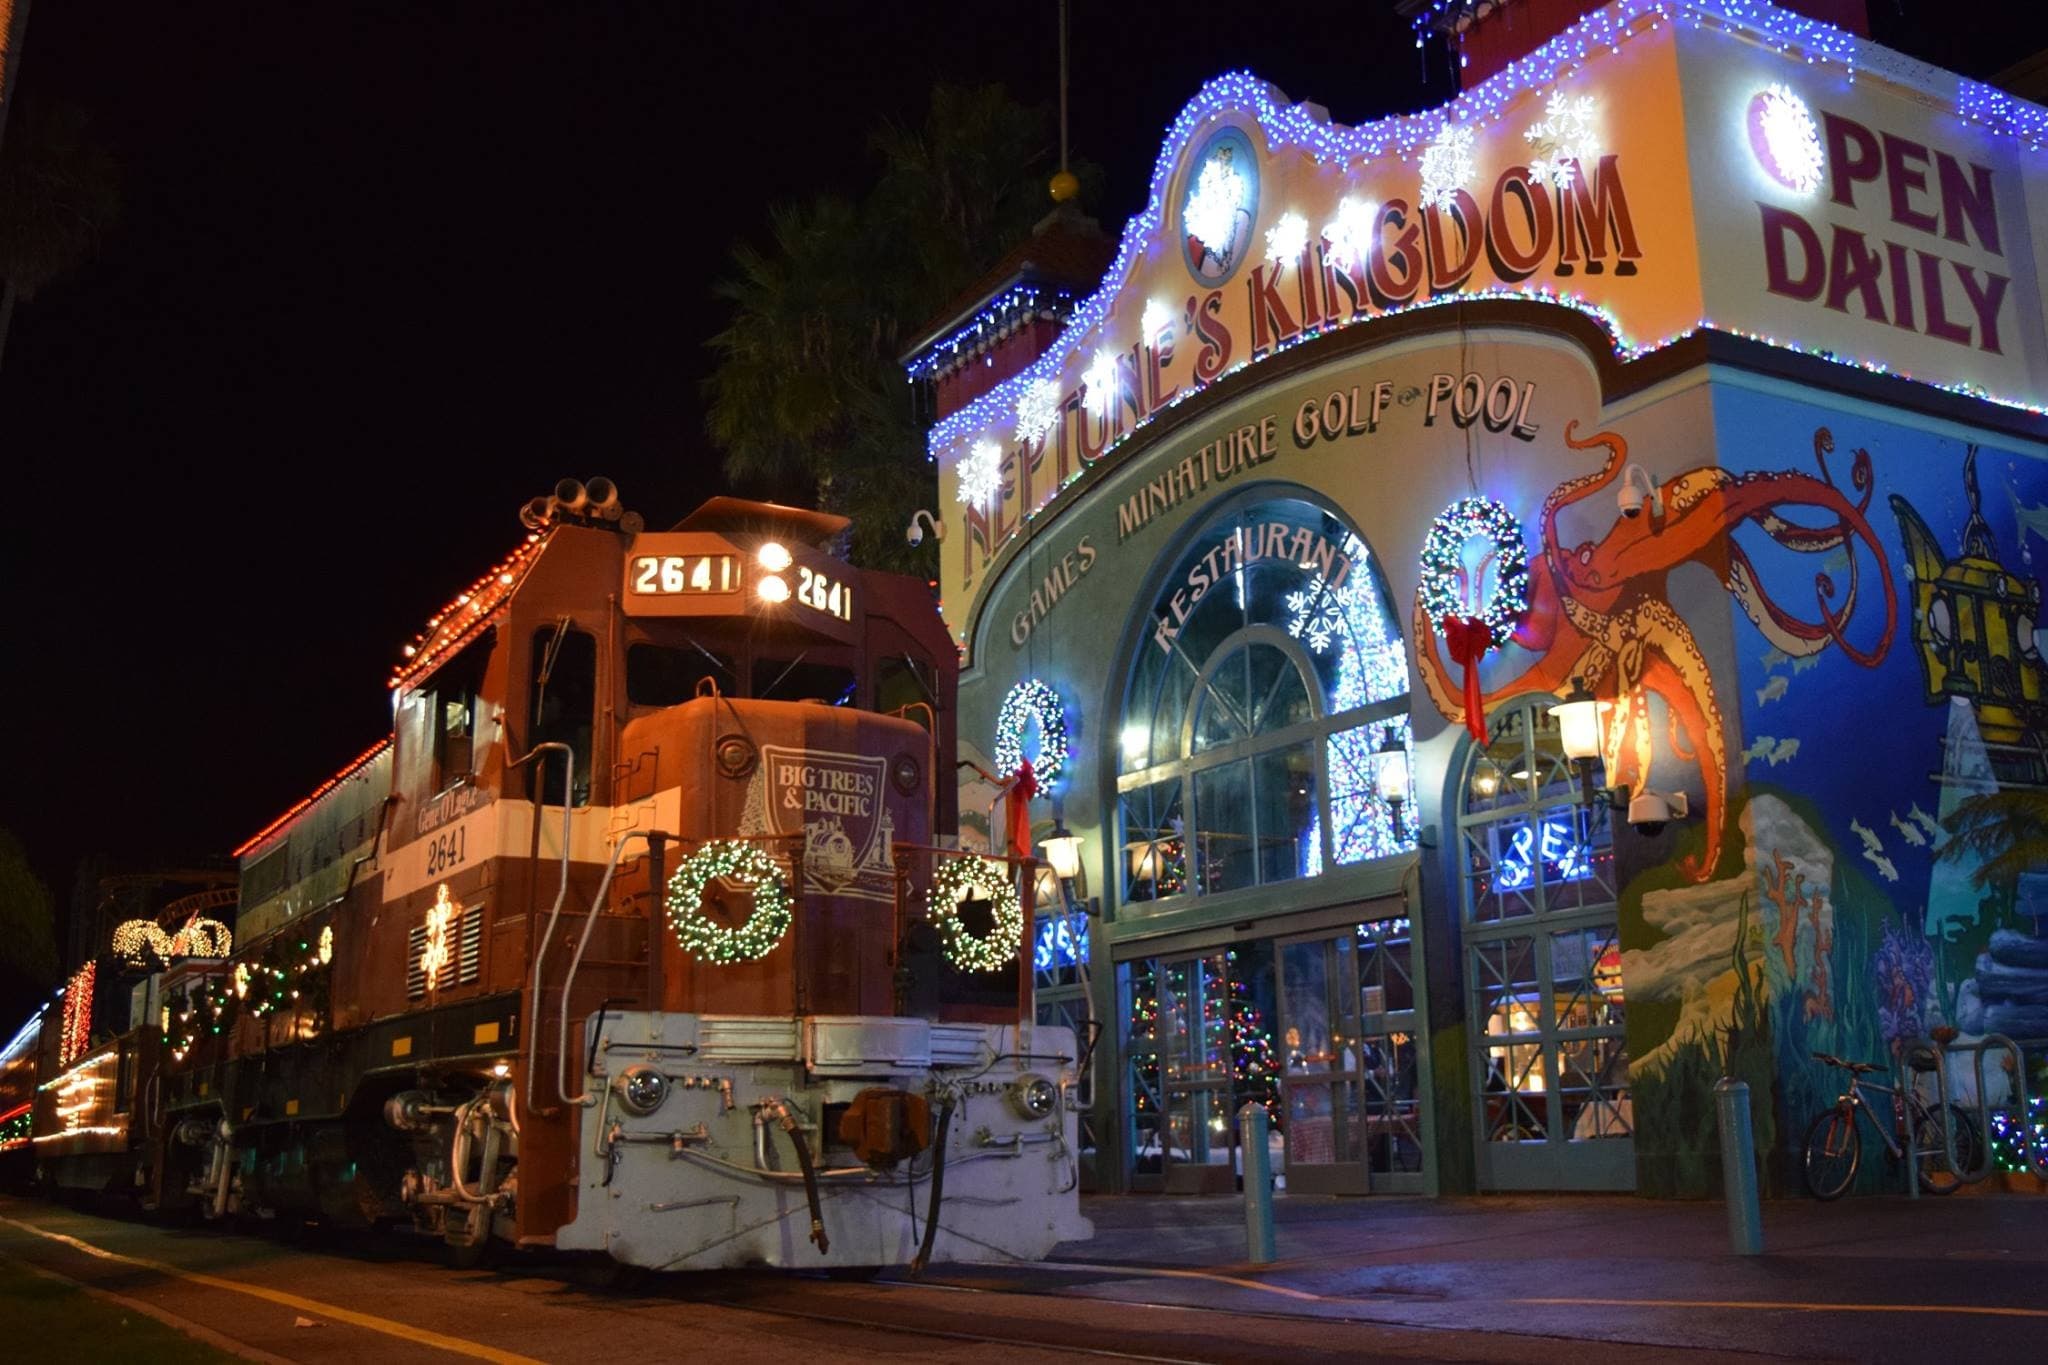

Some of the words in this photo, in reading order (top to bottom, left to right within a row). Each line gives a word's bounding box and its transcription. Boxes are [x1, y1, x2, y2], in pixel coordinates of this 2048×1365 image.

[1249, 154, 1642, 352] KINGDOM
[1755, 201, 2011, 356] DAILY
[1010, 535, 1097, 649] GAMES
[1119, 414, 1277, 541] MINIATURE
[1293, 380, 1393, 447] GOLF
[1426, 372, 1539, 440] POOL
[636, 556, 730, 592] 2641
[798, 565, 851, 621] 2641
[1153, 522, 1352, 656] RESTAURANT
[779, 765, 816, 789] BIG
[819, 768, 873, 795] TREES
[783, 787, 802, 809] &
[805, 790, 870, 817] PACIFIC
[426, 825, 466, 877] 2641
